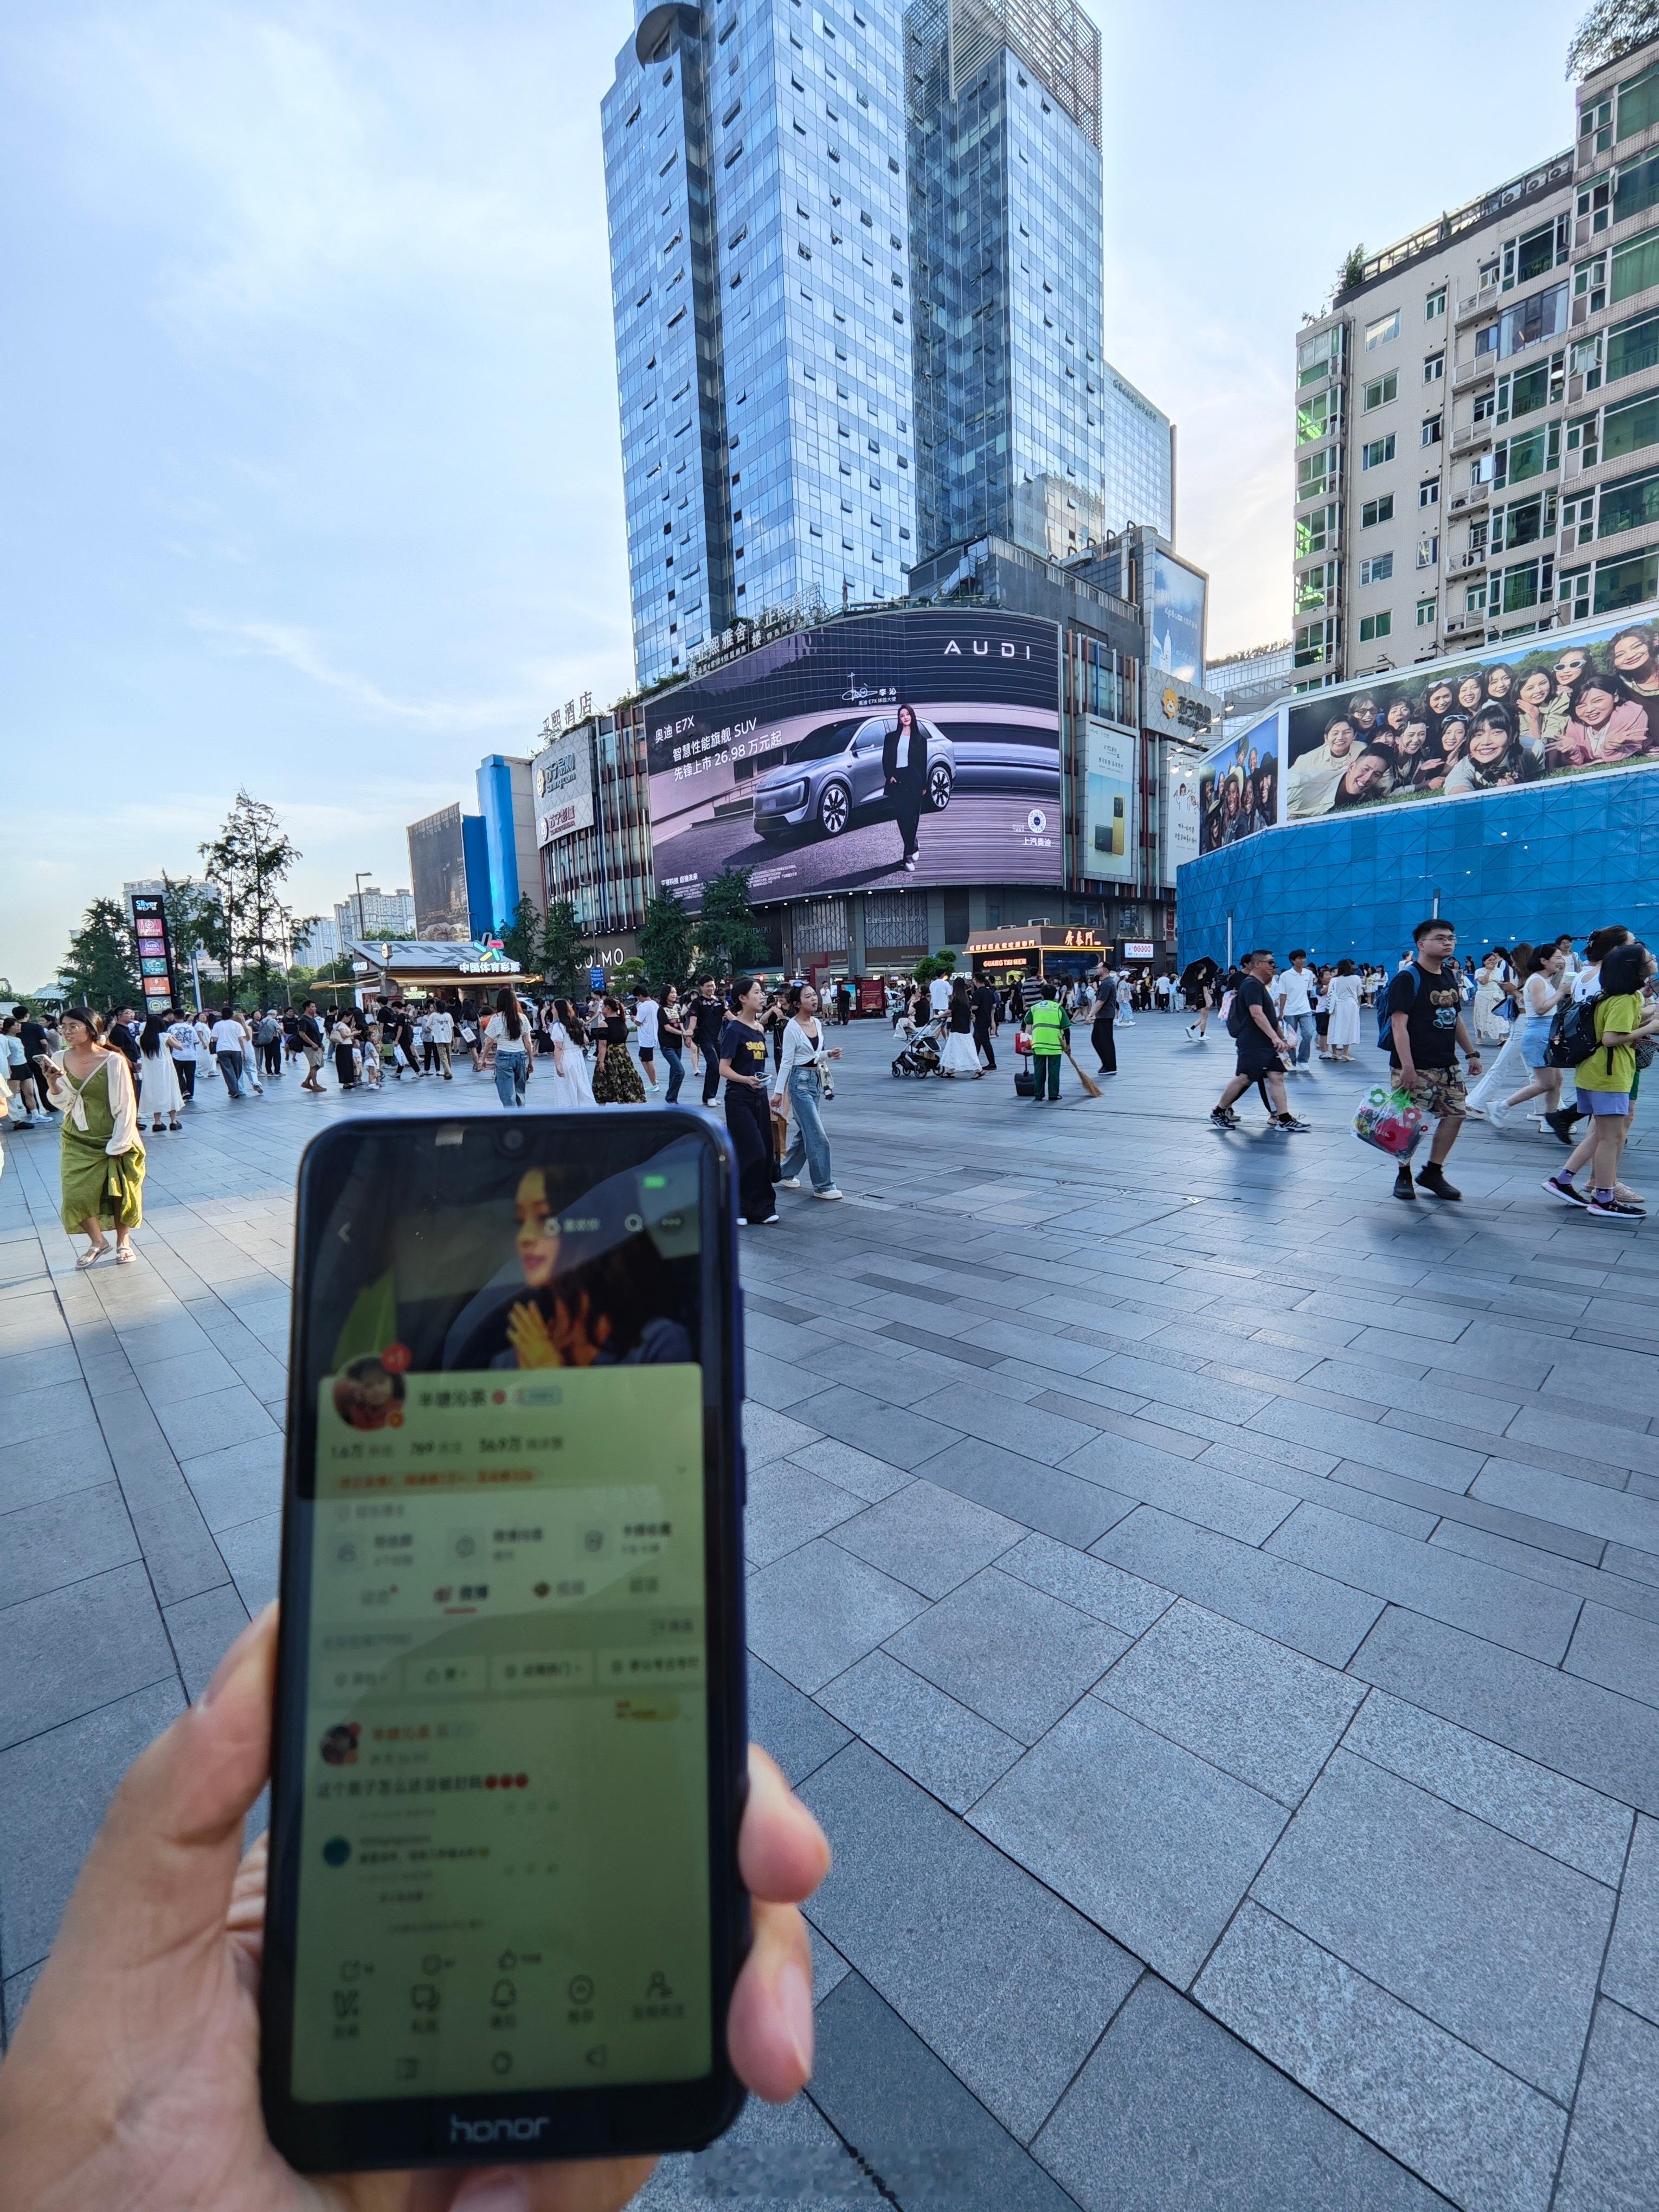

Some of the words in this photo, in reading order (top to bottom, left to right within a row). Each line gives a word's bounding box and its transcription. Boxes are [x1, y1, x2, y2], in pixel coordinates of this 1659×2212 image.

[944, 640, 1030, 660] AUDI
[655, 724, 673, 744] 奥迪
[676, 715, 695, 734] E7X
[673, 726, 732, 762] 智慧性能旗舰
[734, 717, 757, 738] SUV
[674, 756, 711, 782] 先锋上市
[714, 744, 746, 766] 26.98
[748, 730, 782, 756] 万元起
[1022, 837, 1052, 846] 上汽奥迪
[136, 899, 158, 908] Silver
[459, 962, 520, 973] 中国体育彩票
[575, 948, 624, 969] OMO
[450, 2113, 551, 2144] honor
